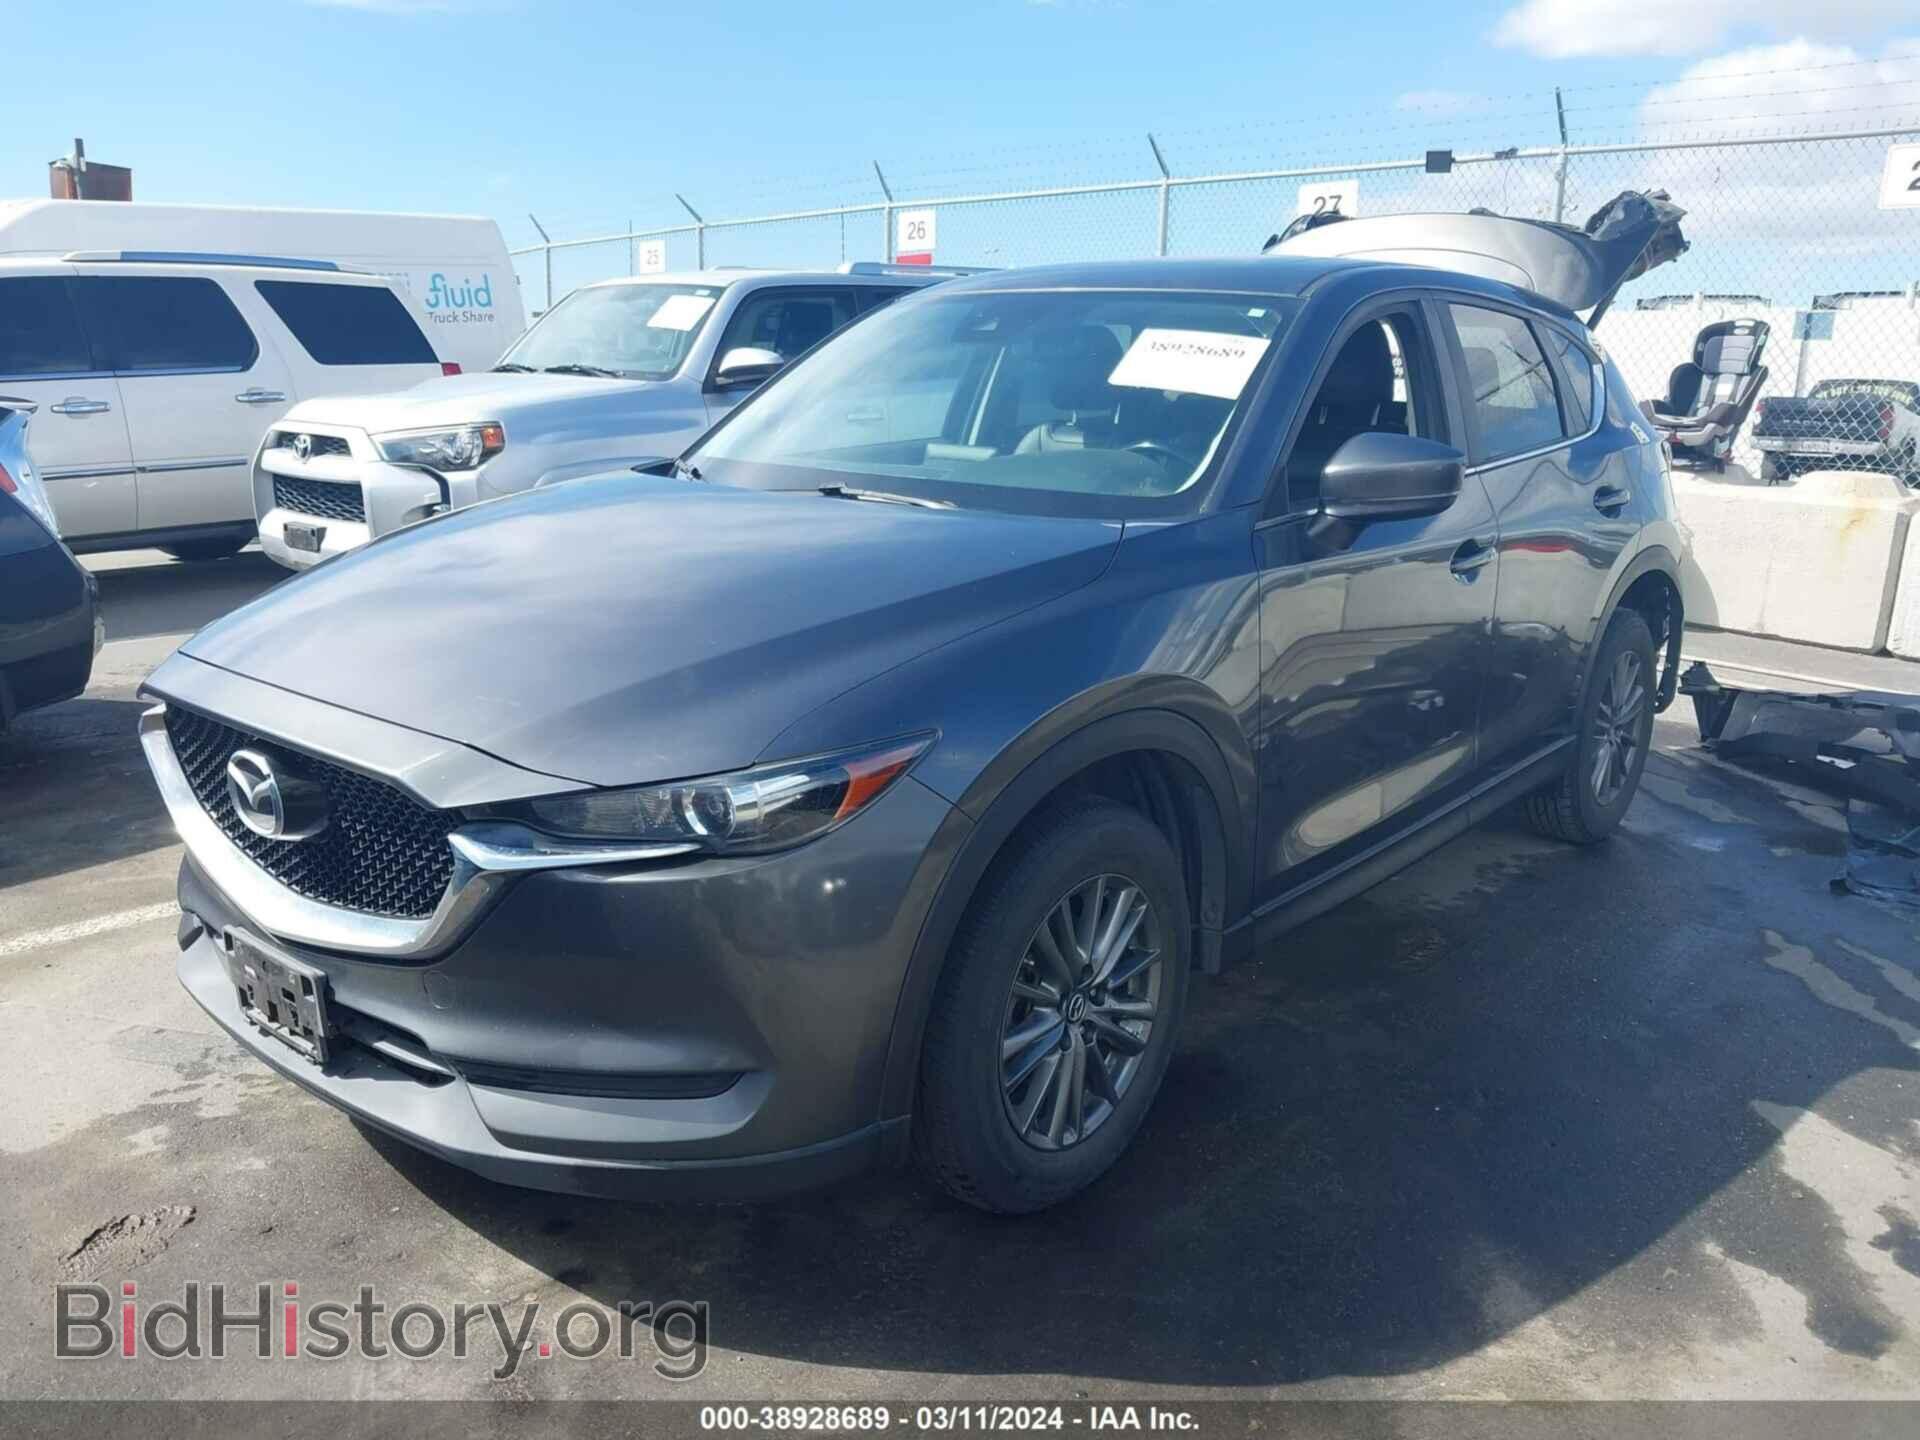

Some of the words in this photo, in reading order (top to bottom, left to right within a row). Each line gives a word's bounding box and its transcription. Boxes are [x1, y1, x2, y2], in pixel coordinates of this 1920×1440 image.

[1313, 195, 1342, 217] 27
[907, 221, 926, 240] 26
[425, 272, 492, 308] fluid
[425, 311, 460, 324] Truck
[462, 310, 494, 323] Share
